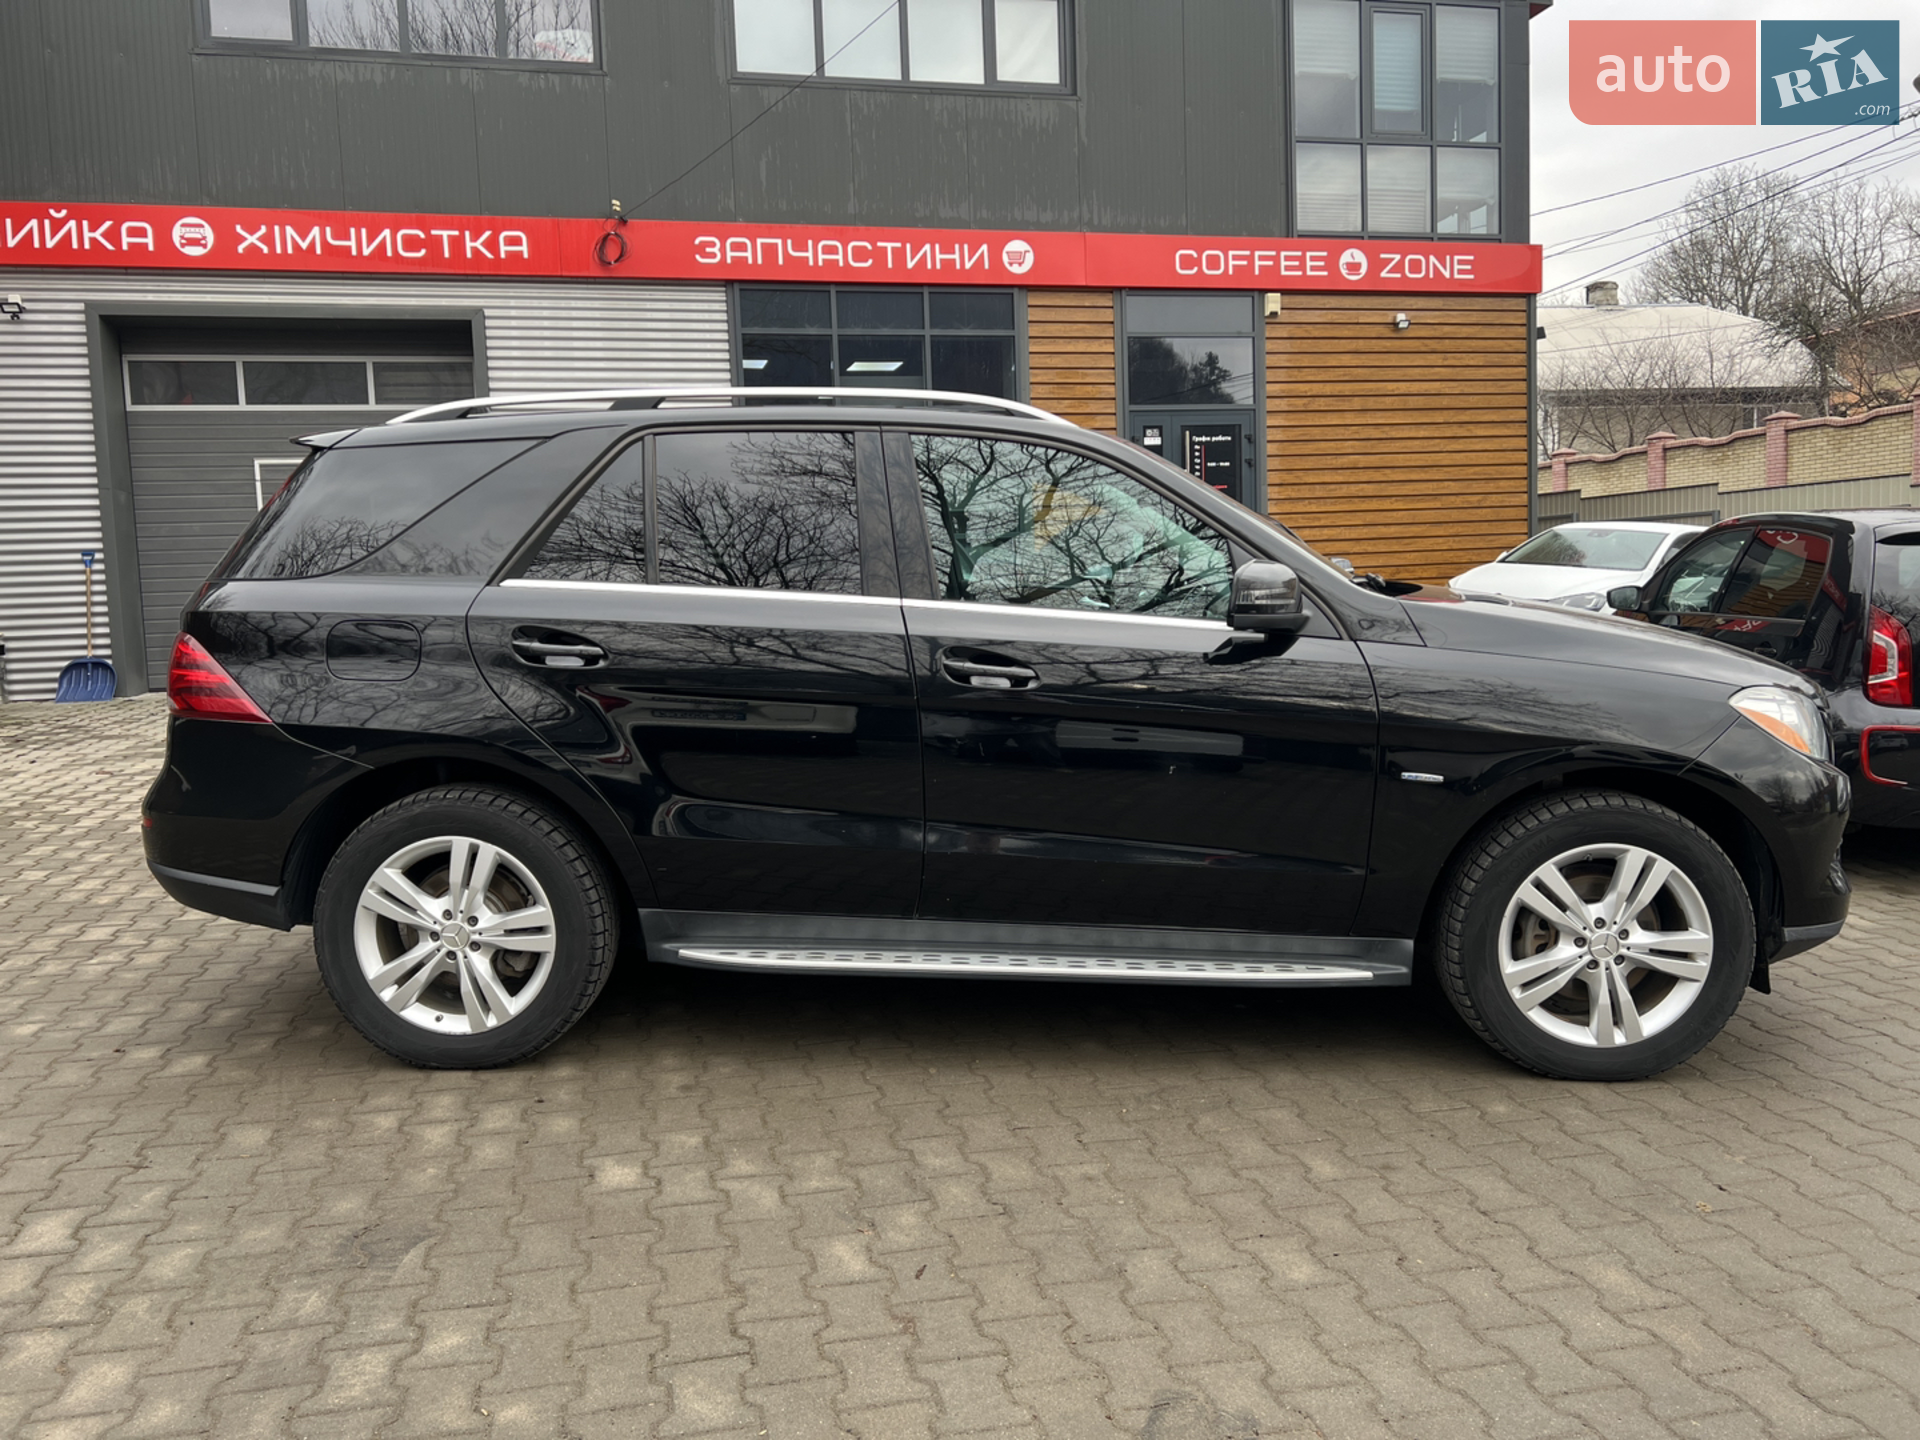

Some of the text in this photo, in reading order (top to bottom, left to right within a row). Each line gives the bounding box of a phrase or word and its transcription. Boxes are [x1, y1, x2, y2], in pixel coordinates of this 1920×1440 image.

[0, 209, 990, 270] ИЙКА ХІМЧИСТКА ЗАПЧАСТИНИ
[1175, 249, 1475, 280] COFFEE ZONE
